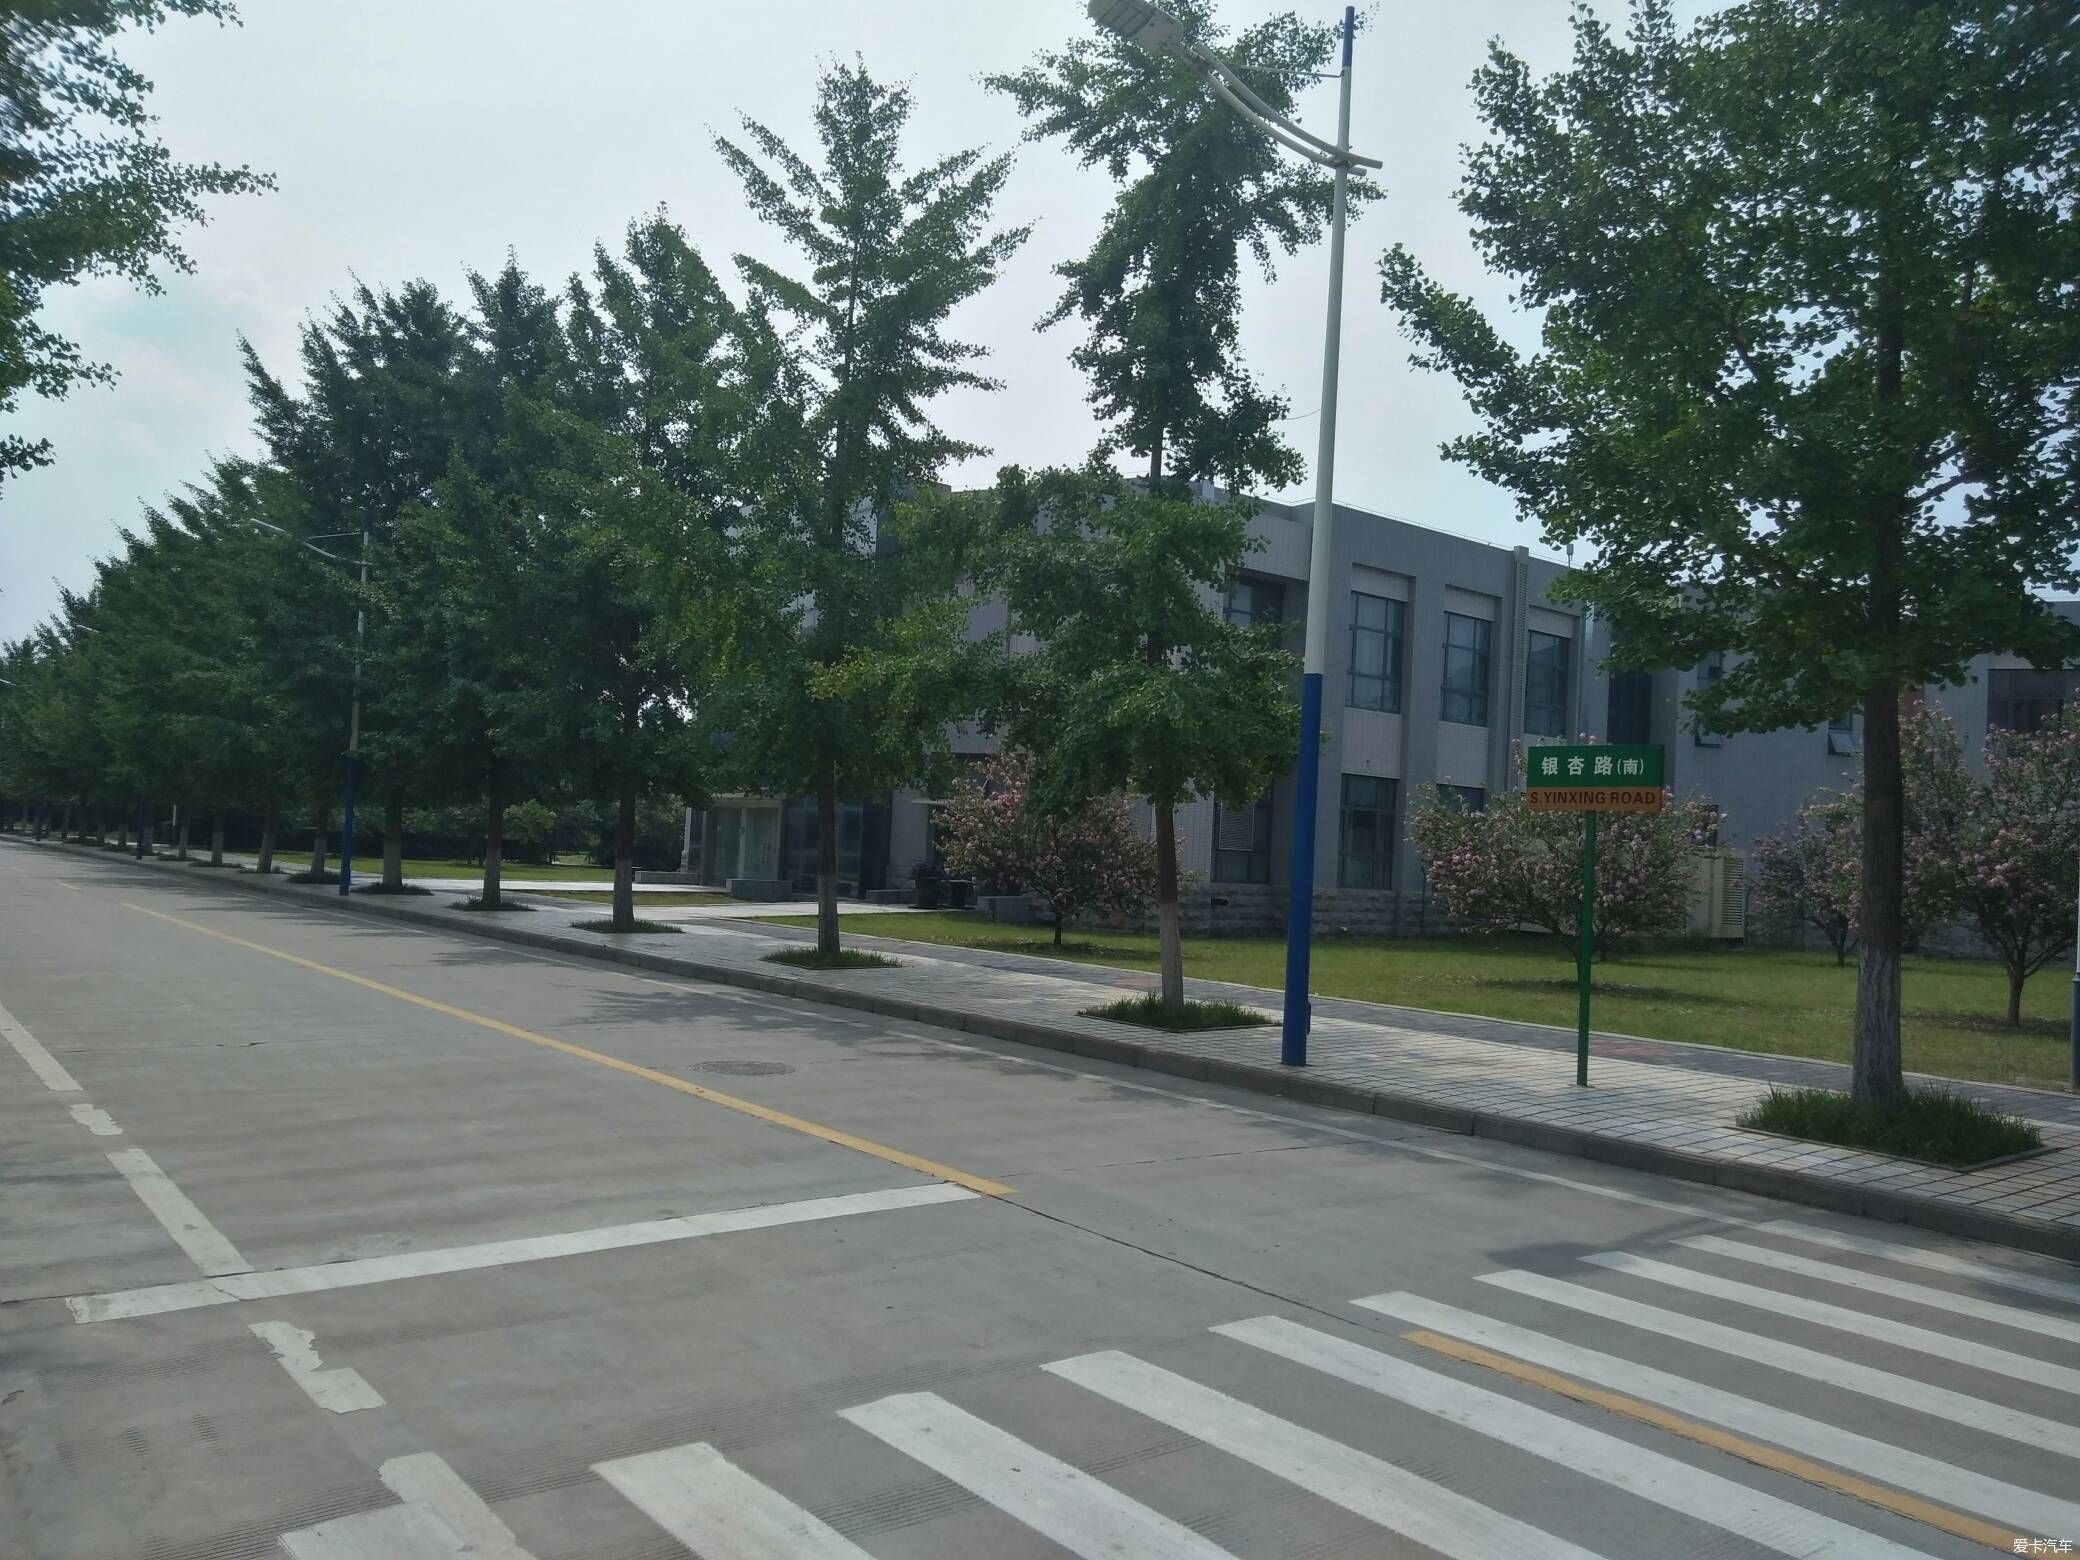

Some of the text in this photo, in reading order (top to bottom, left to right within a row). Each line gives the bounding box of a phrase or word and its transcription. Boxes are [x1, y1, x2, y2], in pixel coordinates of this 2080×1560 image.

[1541, 755, 1644, 776] 银杏路(南)
[1530, 791, 1656, 805] S.YINXING ROAD
